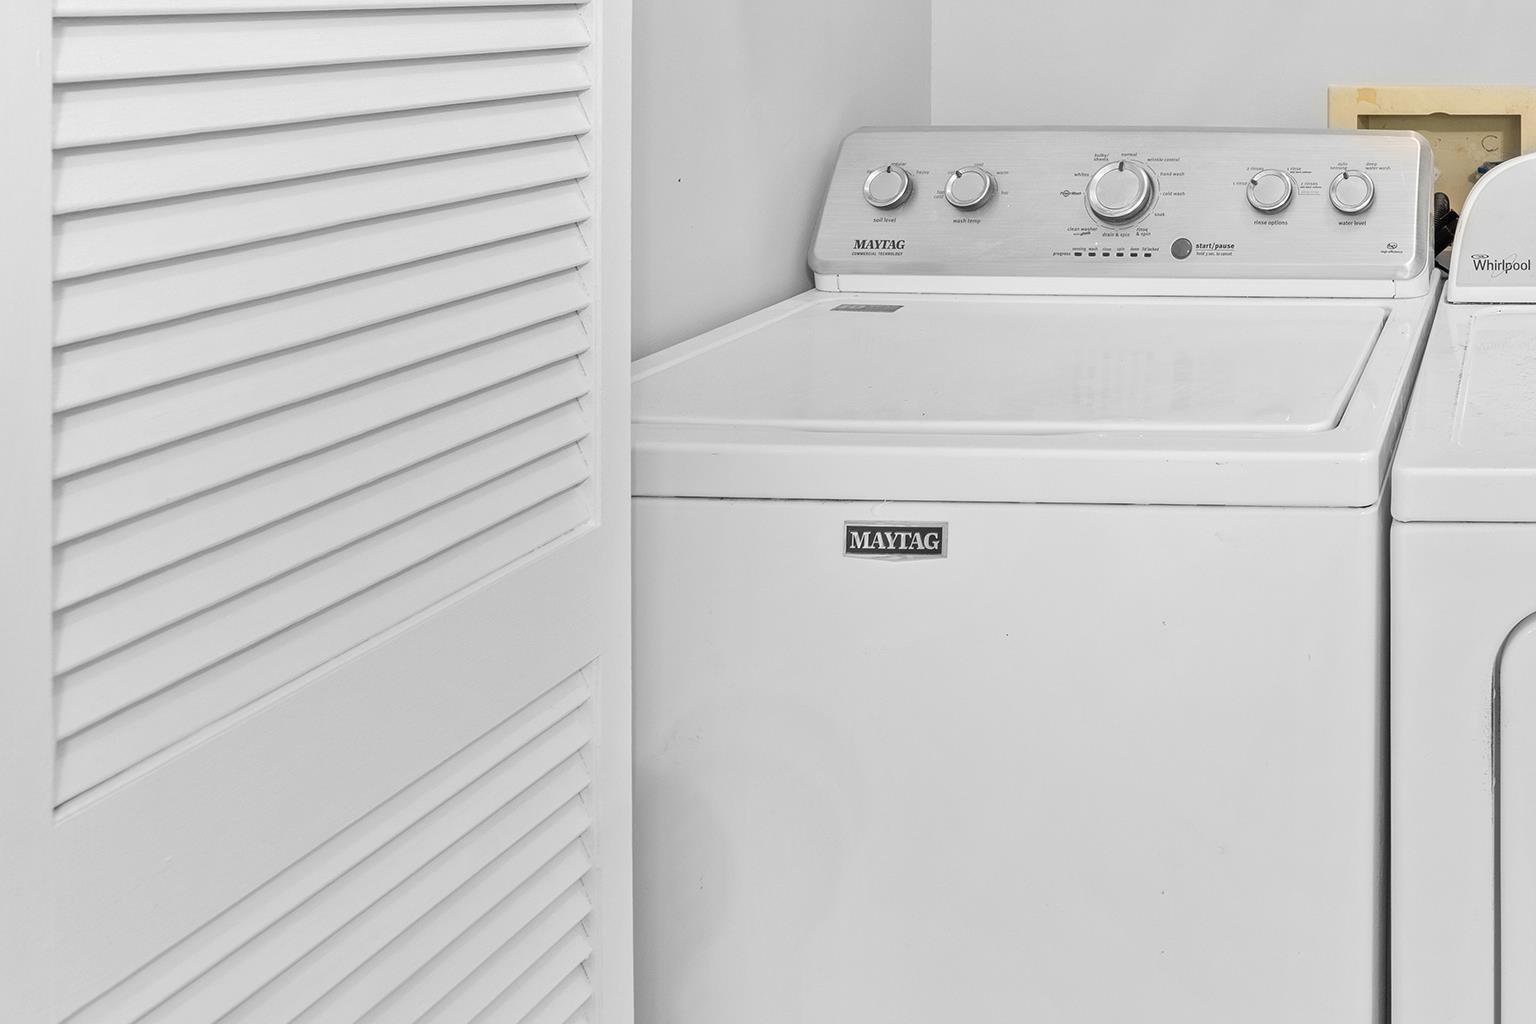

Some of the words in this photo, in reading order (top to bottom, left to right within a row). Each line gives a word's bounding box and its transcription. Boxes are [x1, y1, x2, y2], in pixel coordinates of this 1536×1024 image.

[853, 240, 905, 249] MAYTAG
[1195, 242, 1235, 250] start/pause
[1473, 259, 1531, 274] Whirlpool
[850, 532, 940, 550] MAYTAG
